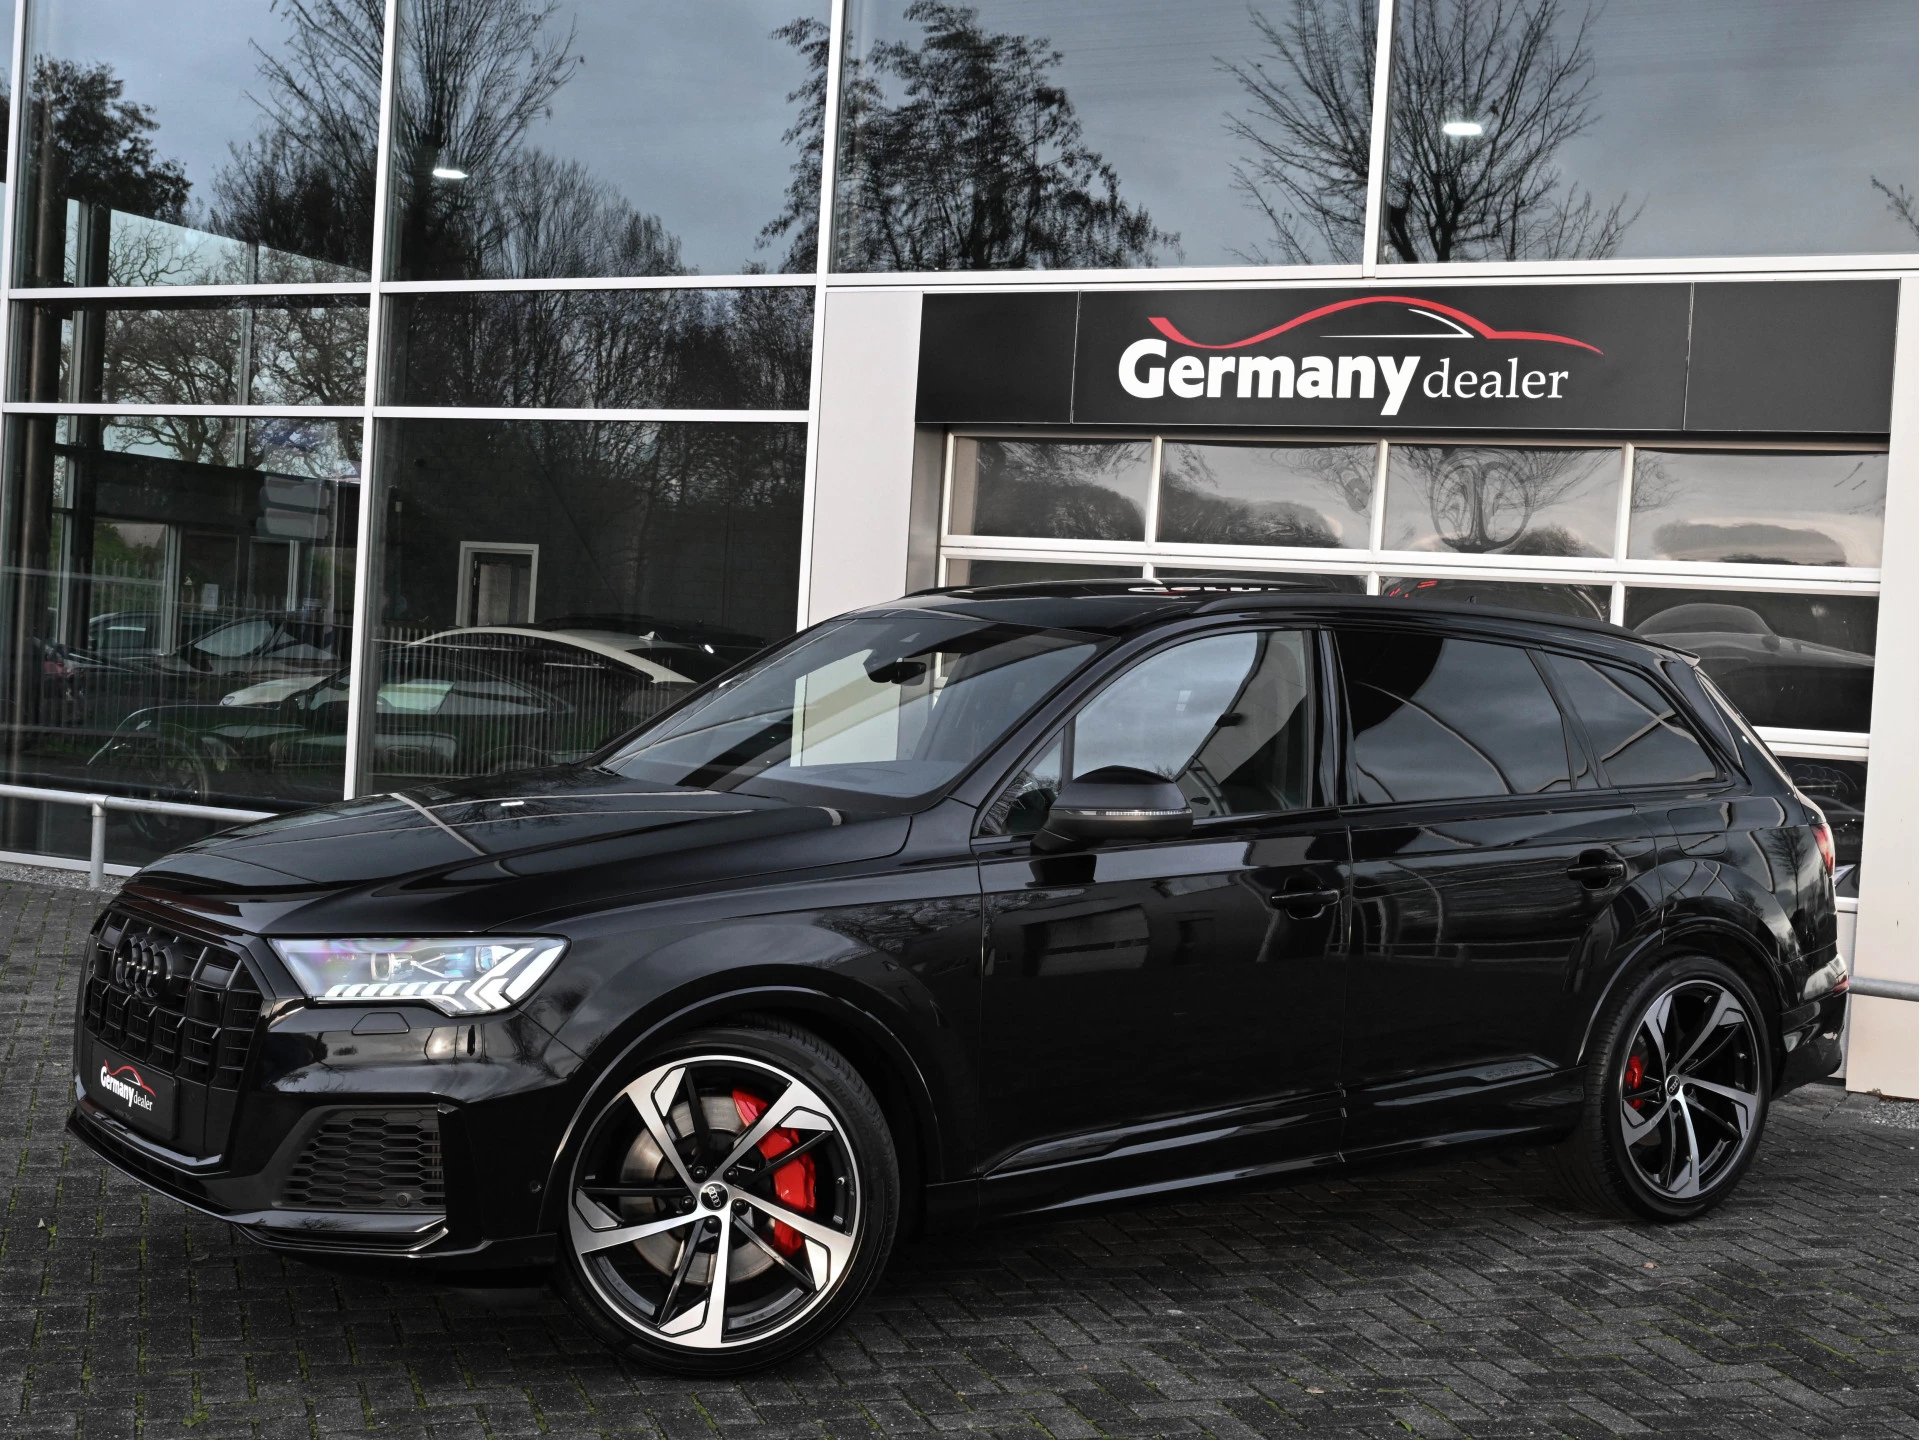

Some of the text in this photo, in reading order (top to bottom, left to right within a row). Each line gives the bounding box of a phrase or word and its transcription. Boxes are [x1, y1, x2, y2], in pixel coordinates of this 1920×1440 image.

[1118, 338, 1569, 416] Germany dealer
[101, 1065, 153, 1111] Germany dealer
